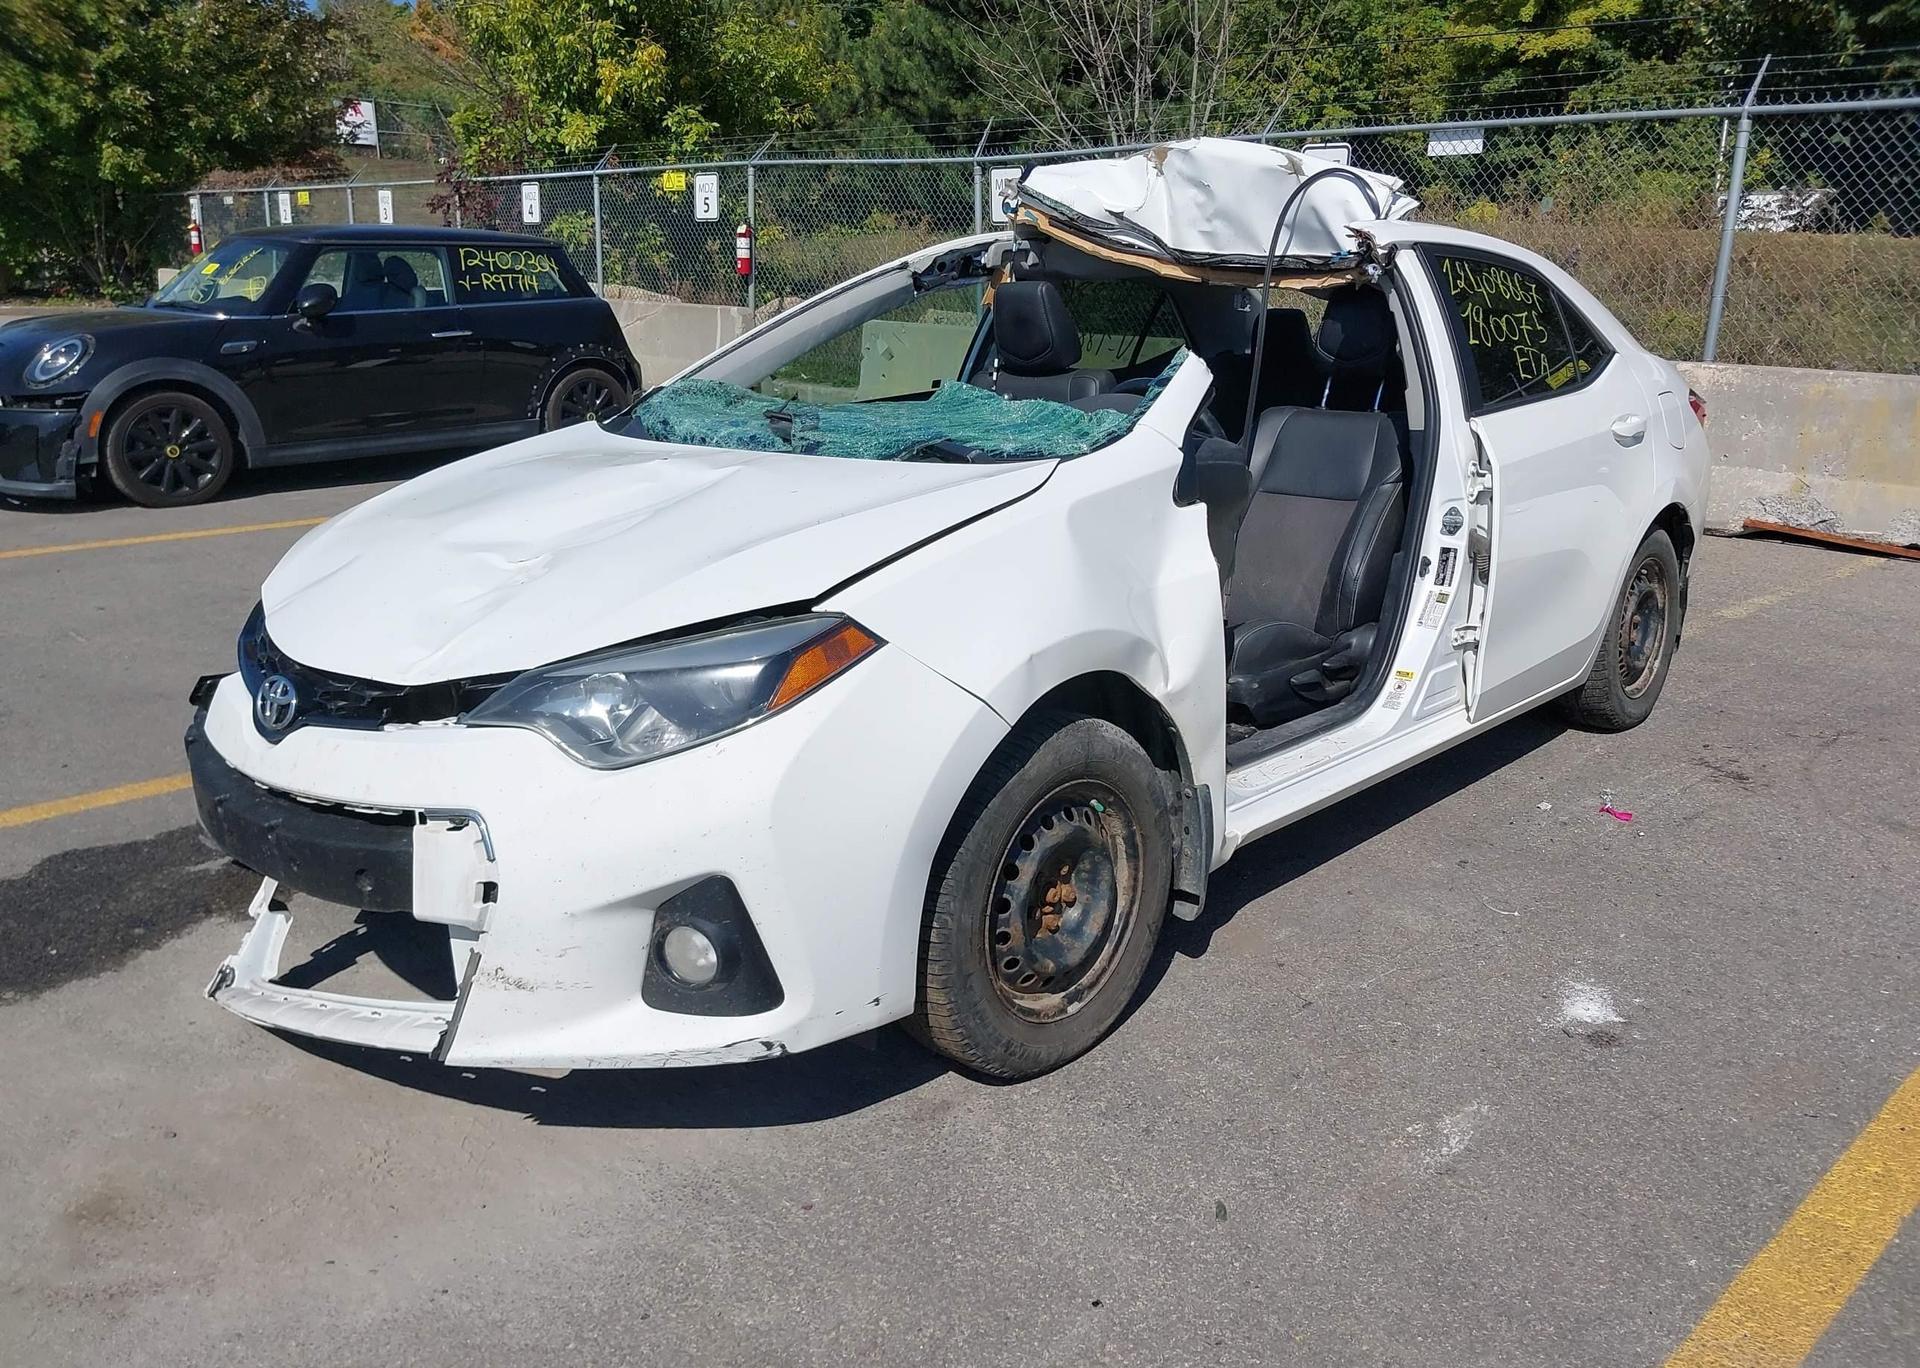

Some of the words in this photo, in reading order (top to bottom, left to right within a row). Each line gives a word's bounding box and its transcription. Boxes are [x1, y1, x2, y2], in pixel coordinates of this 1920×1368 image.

[698, 182, 715, 194] MDZ
[528, 204, 534, 219] 4
[703, 197, 710, 214] 5
[458, 247, 560, 279] 12402304
[1461, 303, 1548, 347] 180075
